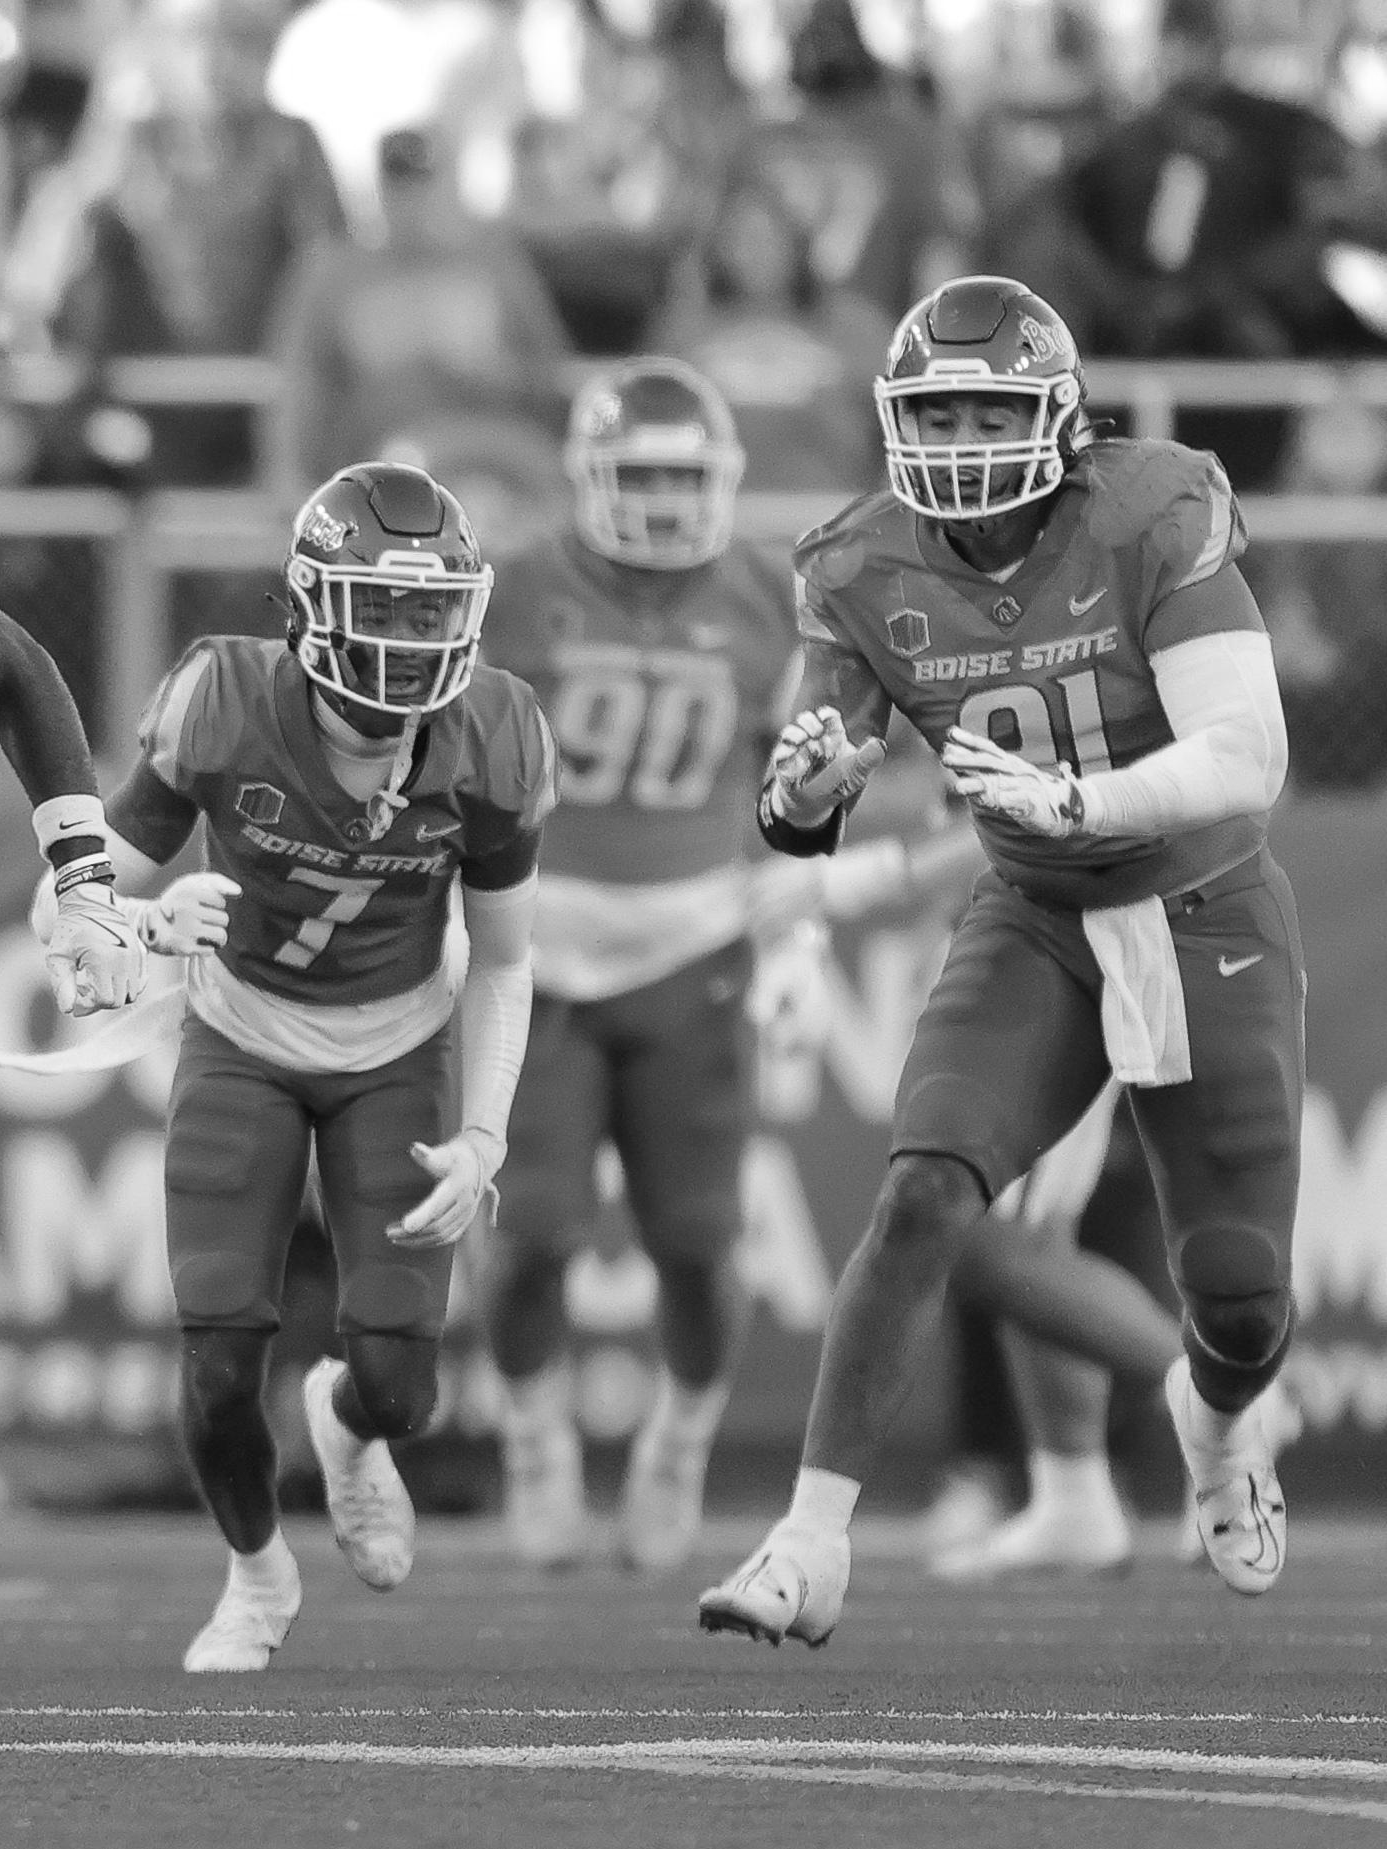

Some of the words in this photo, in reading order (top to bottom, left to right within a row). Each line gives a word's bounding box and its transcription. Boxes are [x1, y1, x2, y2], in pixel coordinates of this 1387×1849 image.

[913, 650, 1013, 682] BOISE
[1021, 624, 1118, 671] STATE
[557, 670, 737, 809] 90
[959, 669, 1113, 780] 91
[241, 823, 349, 868] BOISE
[274, 865, 386, 969] 7
